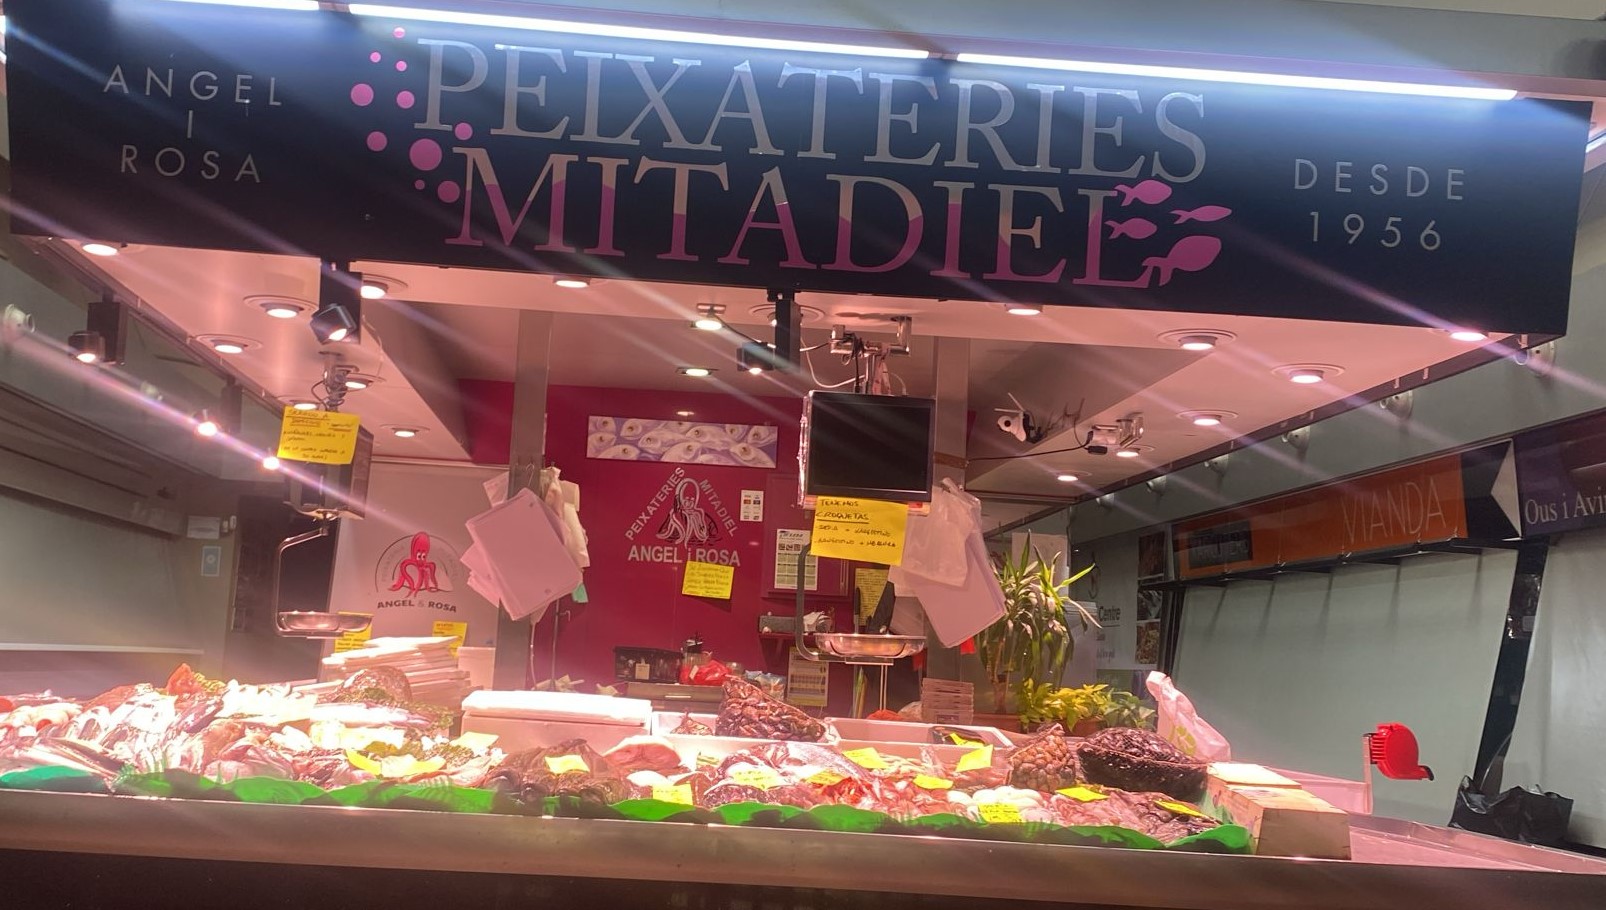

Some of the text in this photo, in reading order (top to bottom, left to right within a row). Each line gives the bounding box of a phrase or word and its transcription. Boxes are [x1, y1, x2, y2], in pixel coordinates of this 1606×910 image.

[104, 64, 282, 106] ANGEL
[186, 109, 194, 139] I
[414, 38, 1206, 182] PEIXATERIES
[120, 144, 260, 183] ROSA
[1294, 158, 1464, 200] DESDE
[444, 146, 1154, 288] MITADIEL
[1310, 211, 1441, 250] 1956
[625, 467, 685, 540] PEIXATERIES
[699, 479, 738, 537] MITADIEL
[816, 512, 869, 520] CROQUETAS
[820, 499, 859, 507] TENEMOS
[1342, 477, 1447, 545] VIANDA
[1525, 499, 1558, 524] Ous
[1563, 493, 1569, 518] i
[628, 545, 683, 563] ANGEL
[695, 548, 740, 567] ROSA
[377, 600, 414, 609] ANGEL
[428, 601, 457, 612] ROSA
[1099, 606, 1121, 622] Centre
